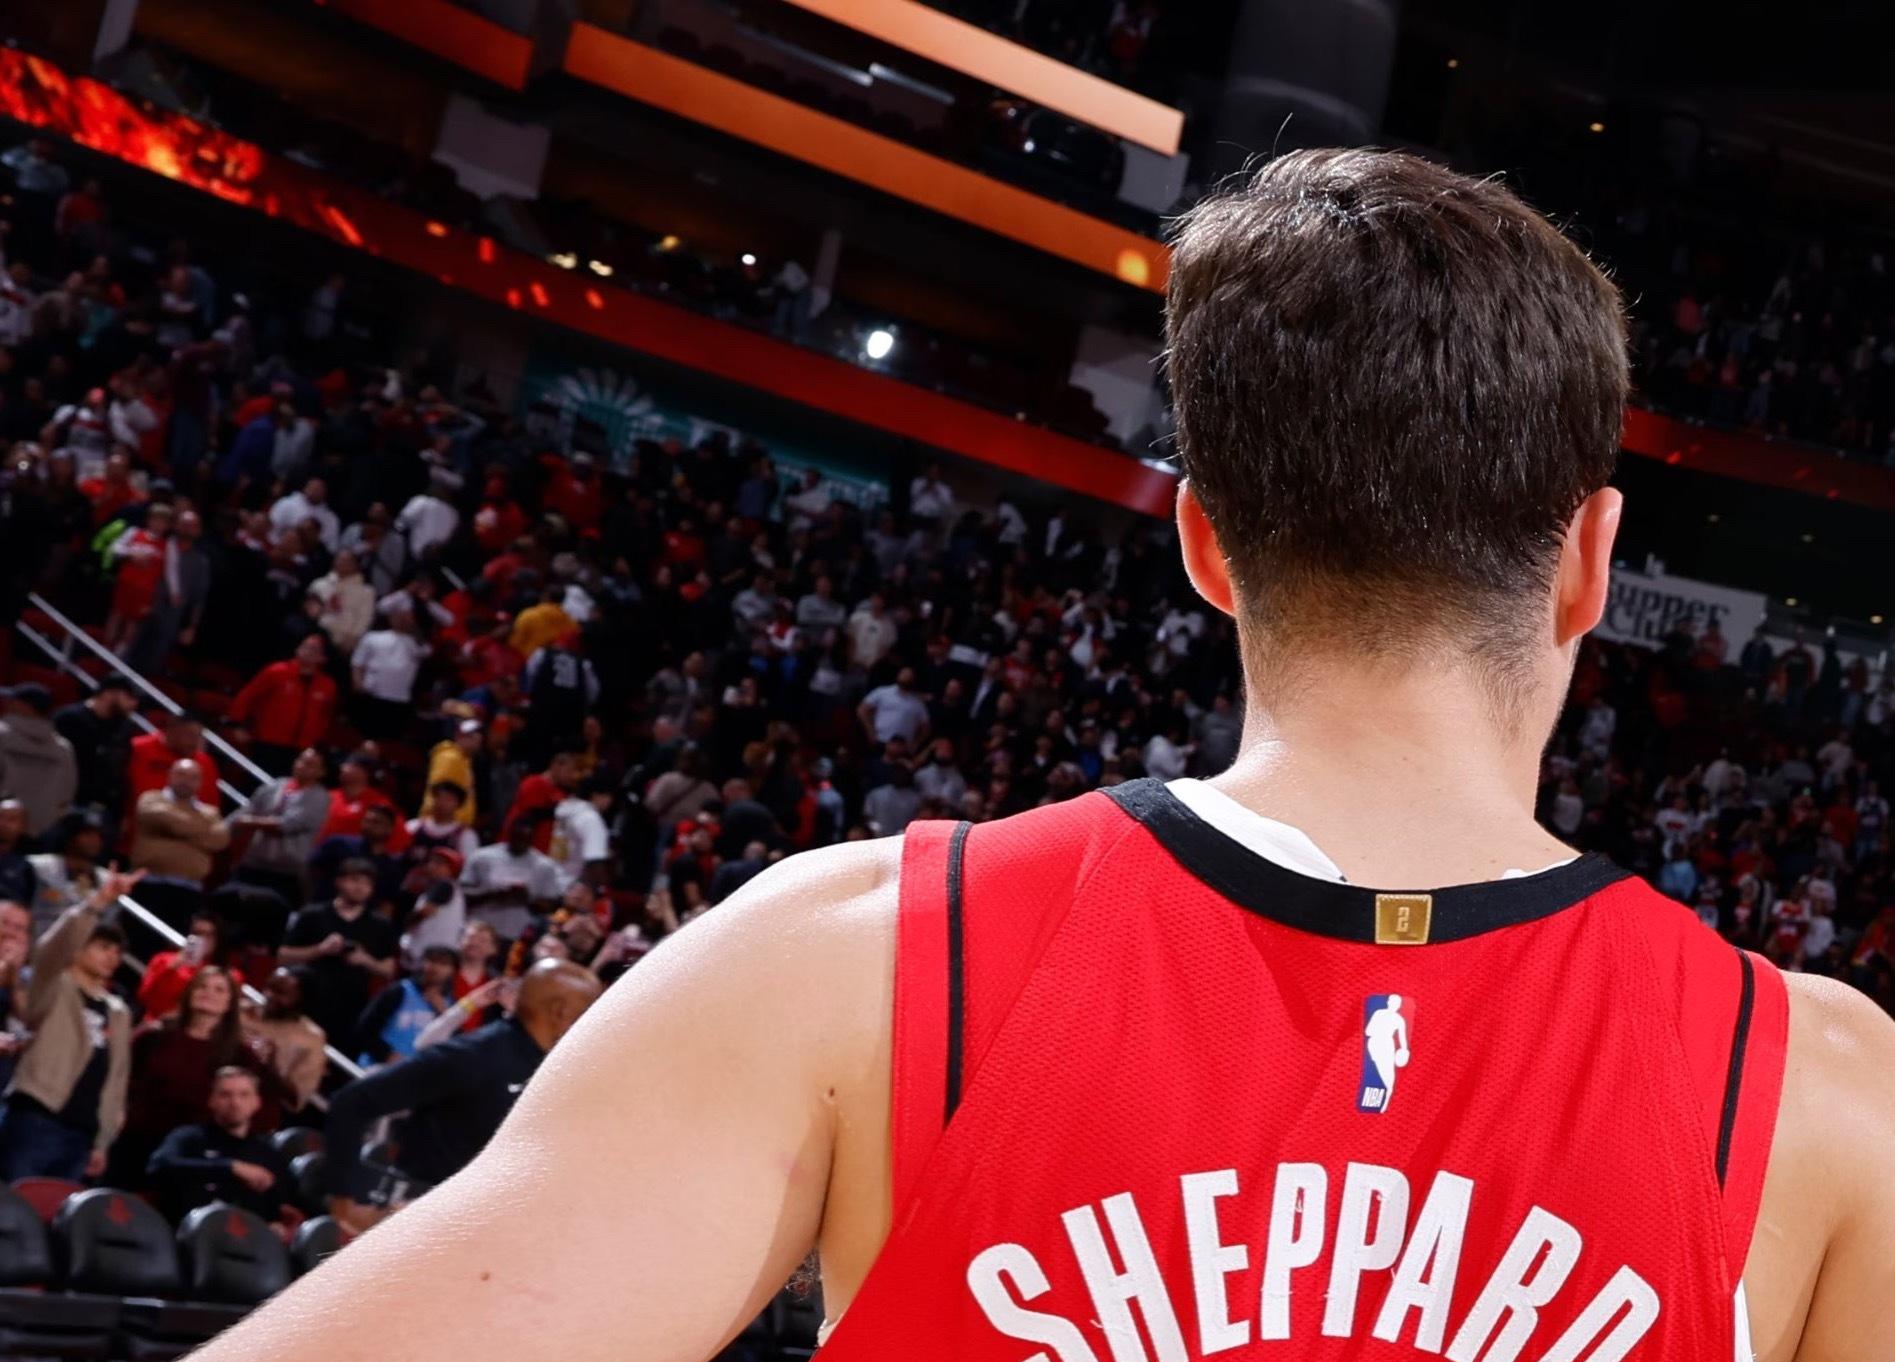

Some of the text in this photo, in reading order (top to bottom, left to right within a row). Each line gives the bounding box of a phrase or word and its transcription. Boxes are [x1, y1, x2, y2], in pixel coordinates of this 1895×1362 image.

[1612, 582, 1731, 634] upper
[1395, 906, 1410, 933] 2
[1361, 1087, 1386, 1108] NBA
